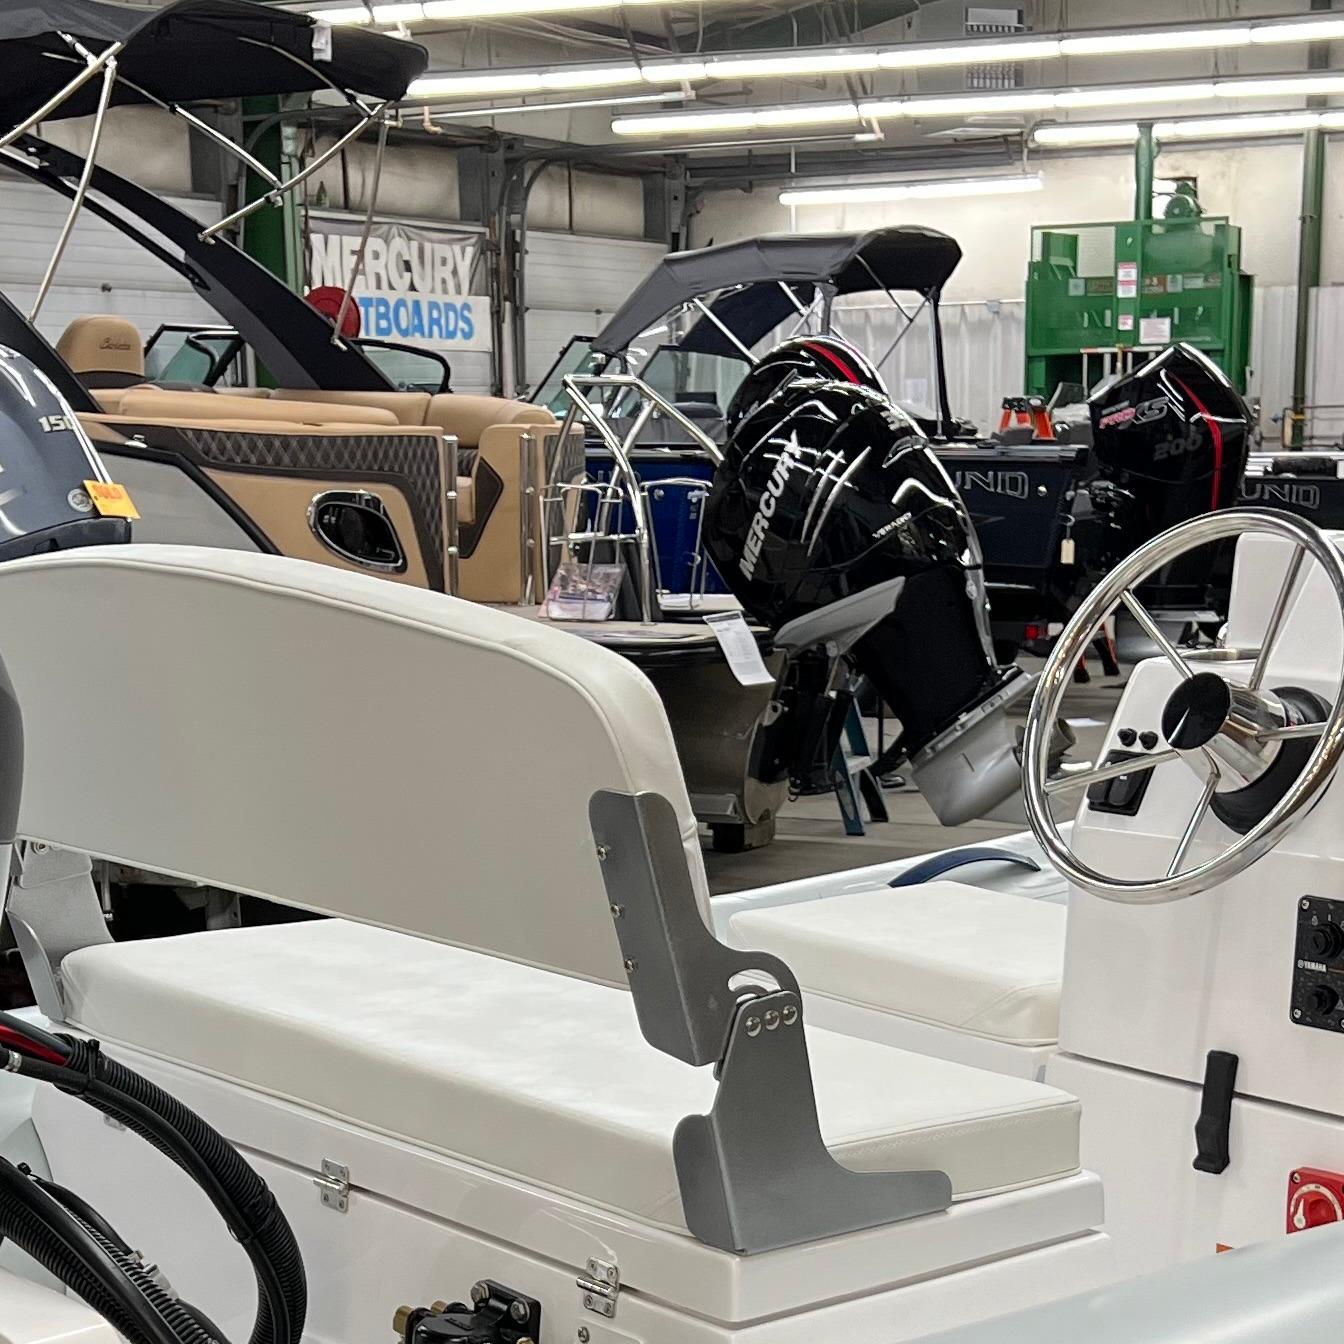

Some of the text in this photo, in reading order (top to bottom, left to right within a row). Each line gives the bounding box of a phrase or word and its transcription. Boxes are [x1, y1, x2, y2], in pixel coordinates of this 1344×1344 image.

[310, 233, 474, 297] MERCURY
[357, 296, 475, 341] TBOARDS
[1238, 483, 1320, 509] UND
